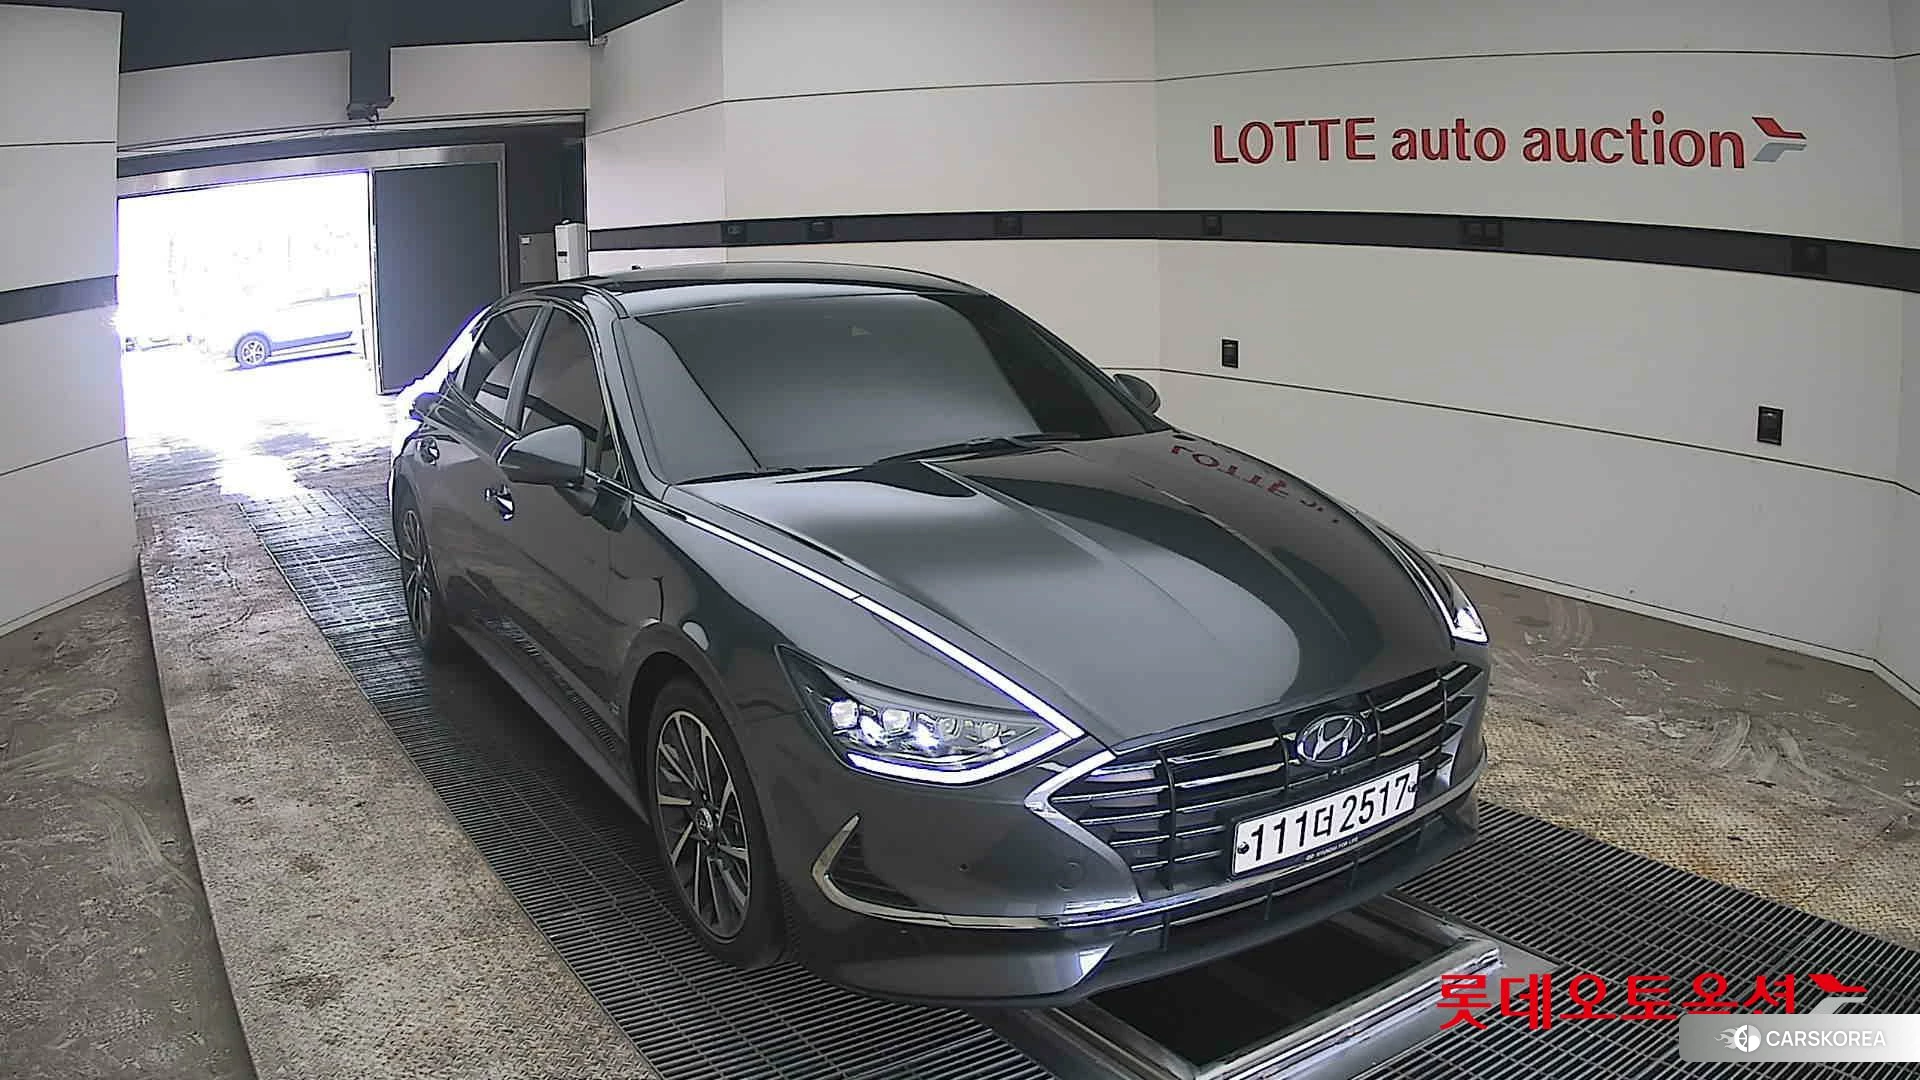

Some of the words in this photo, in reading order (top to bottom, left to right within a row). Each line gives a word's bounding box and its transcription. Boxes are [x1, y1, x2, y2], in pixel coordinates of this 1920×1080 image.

[1213, 117, 1376, 164] LOTTE
[1391, 118, 1507, 162] auto
[1522, 110, 1745, 169] auction
